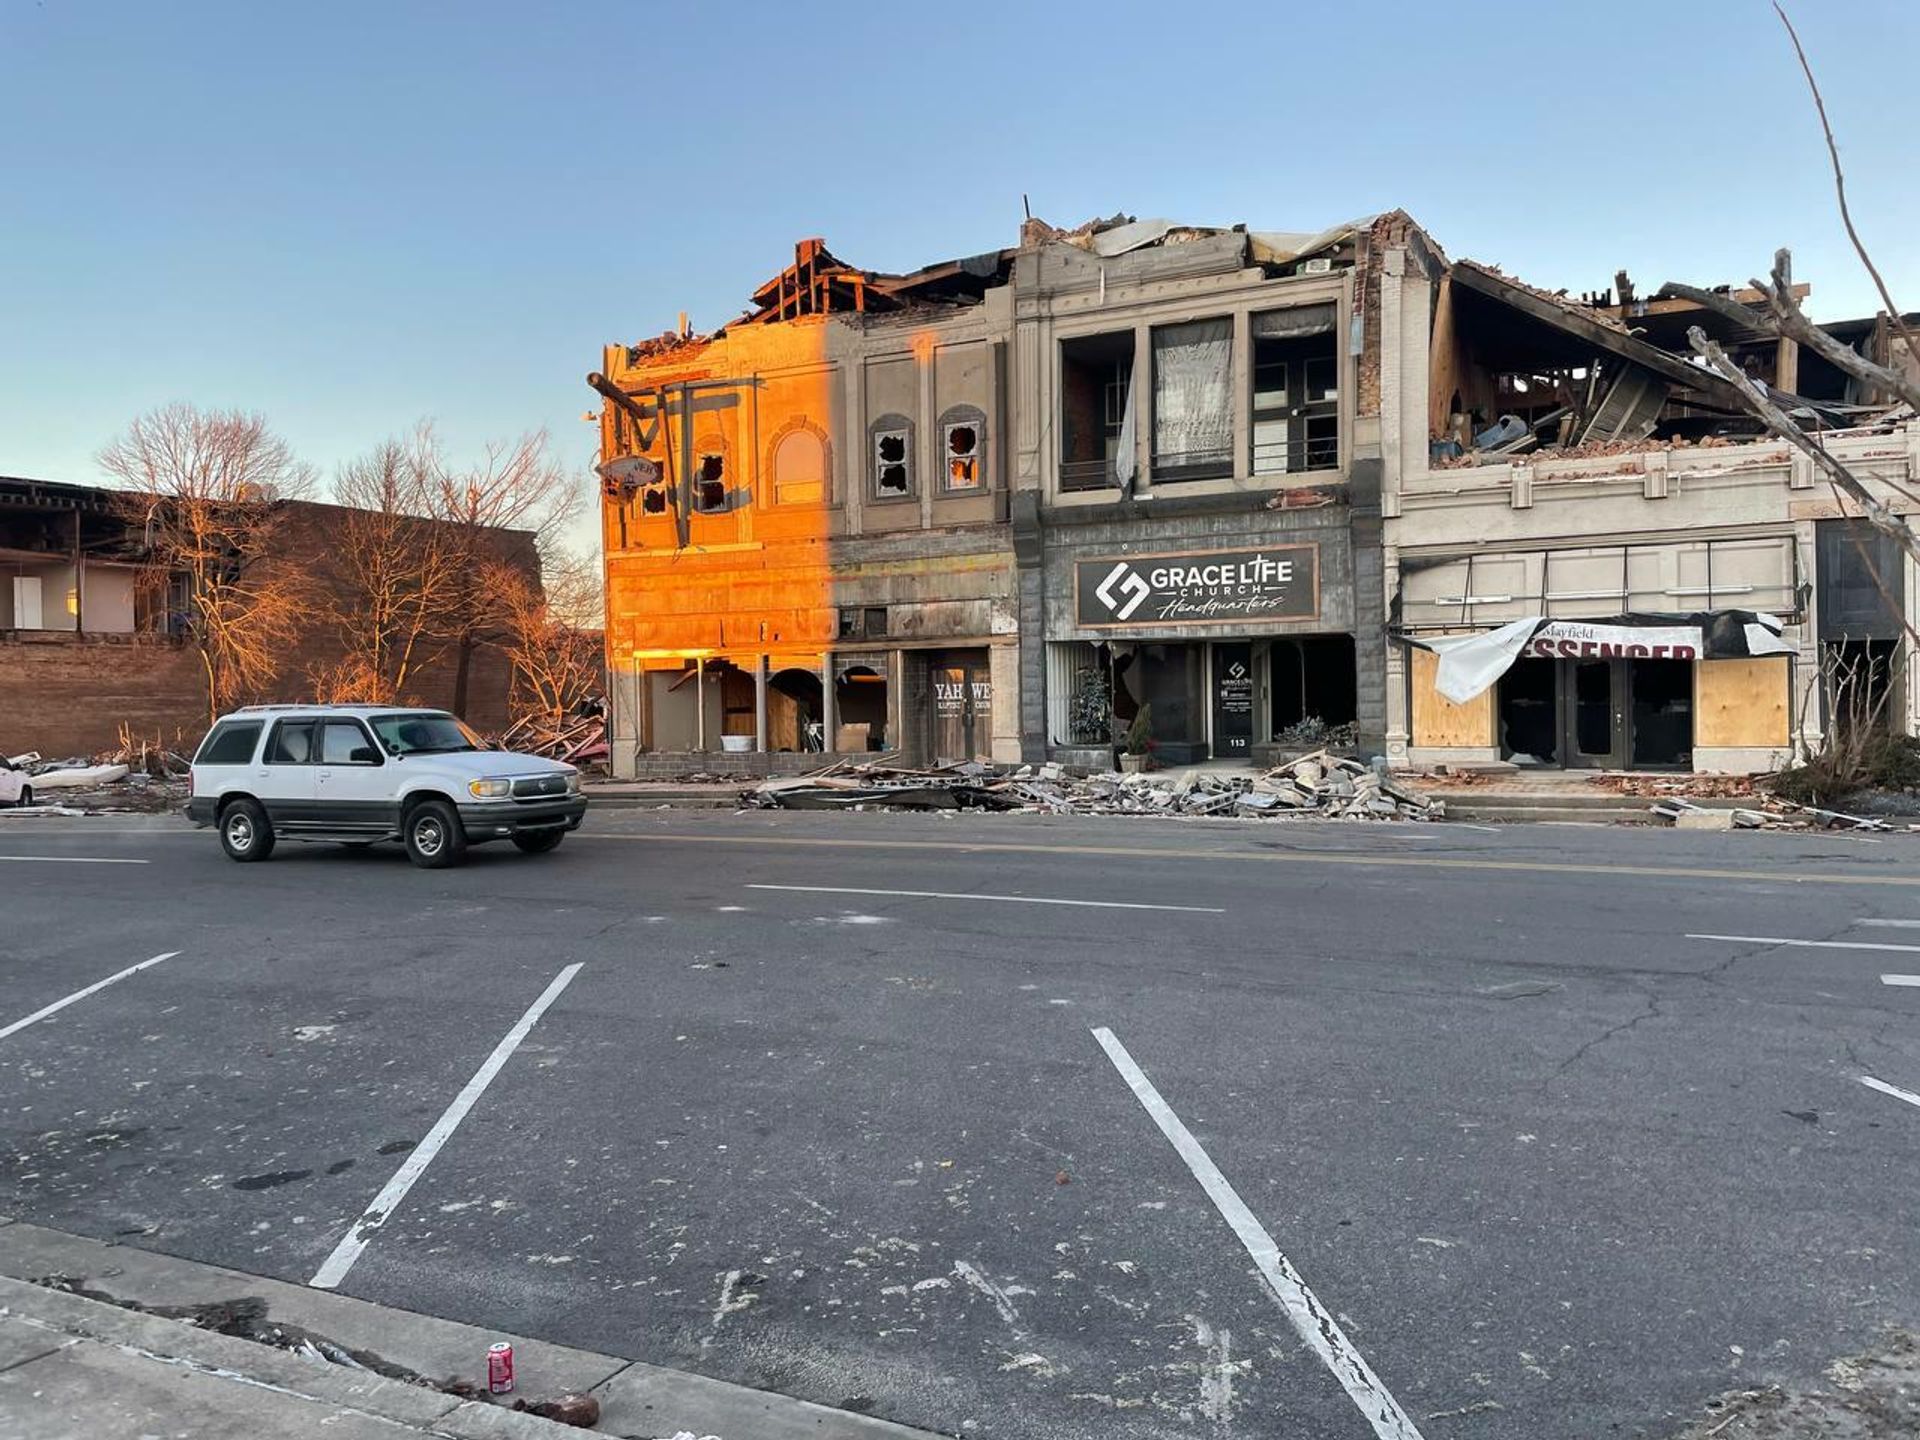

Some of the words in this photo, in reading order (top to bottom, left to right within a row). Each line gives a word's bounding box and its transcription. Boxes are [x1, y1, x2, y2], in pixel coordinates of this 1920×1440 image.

[1150, 564, 1236, 588] GRACE
[1240, 553, 1293, 584] LIFE
[1180, 584, 1261, 597] CHURCH
[1156, 595, 1285, 619] Headquarters
[1542, 624, 1594, 640] Mayfield
[1230, 739, 1246, 747] 113
